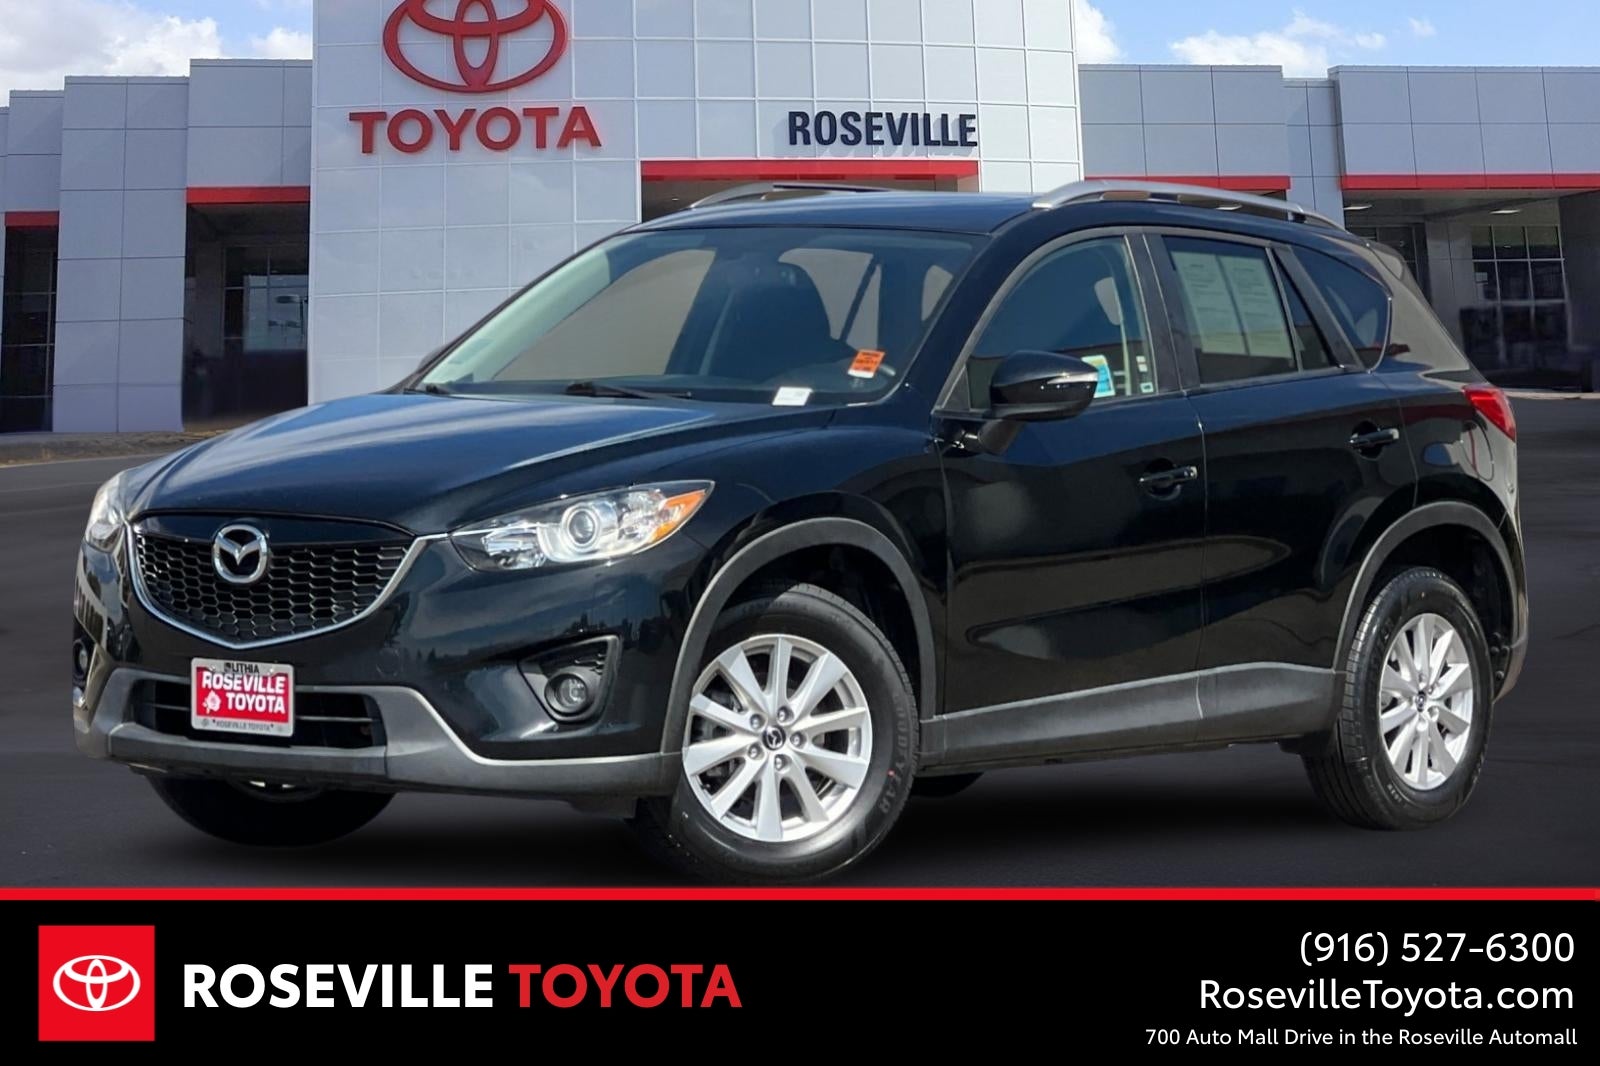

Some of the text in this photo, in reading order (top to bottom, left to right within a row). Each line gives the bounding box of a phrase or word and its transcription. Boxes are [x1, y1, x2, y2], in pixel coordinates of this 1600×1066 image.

[349, 106, 602, 154] TOYOTA
[788, 110, 978, 147] ROSEVILLE
[202, 671, 286, 694] ROSEVILLE
[225, 692, 286, 714] TOYOTA
